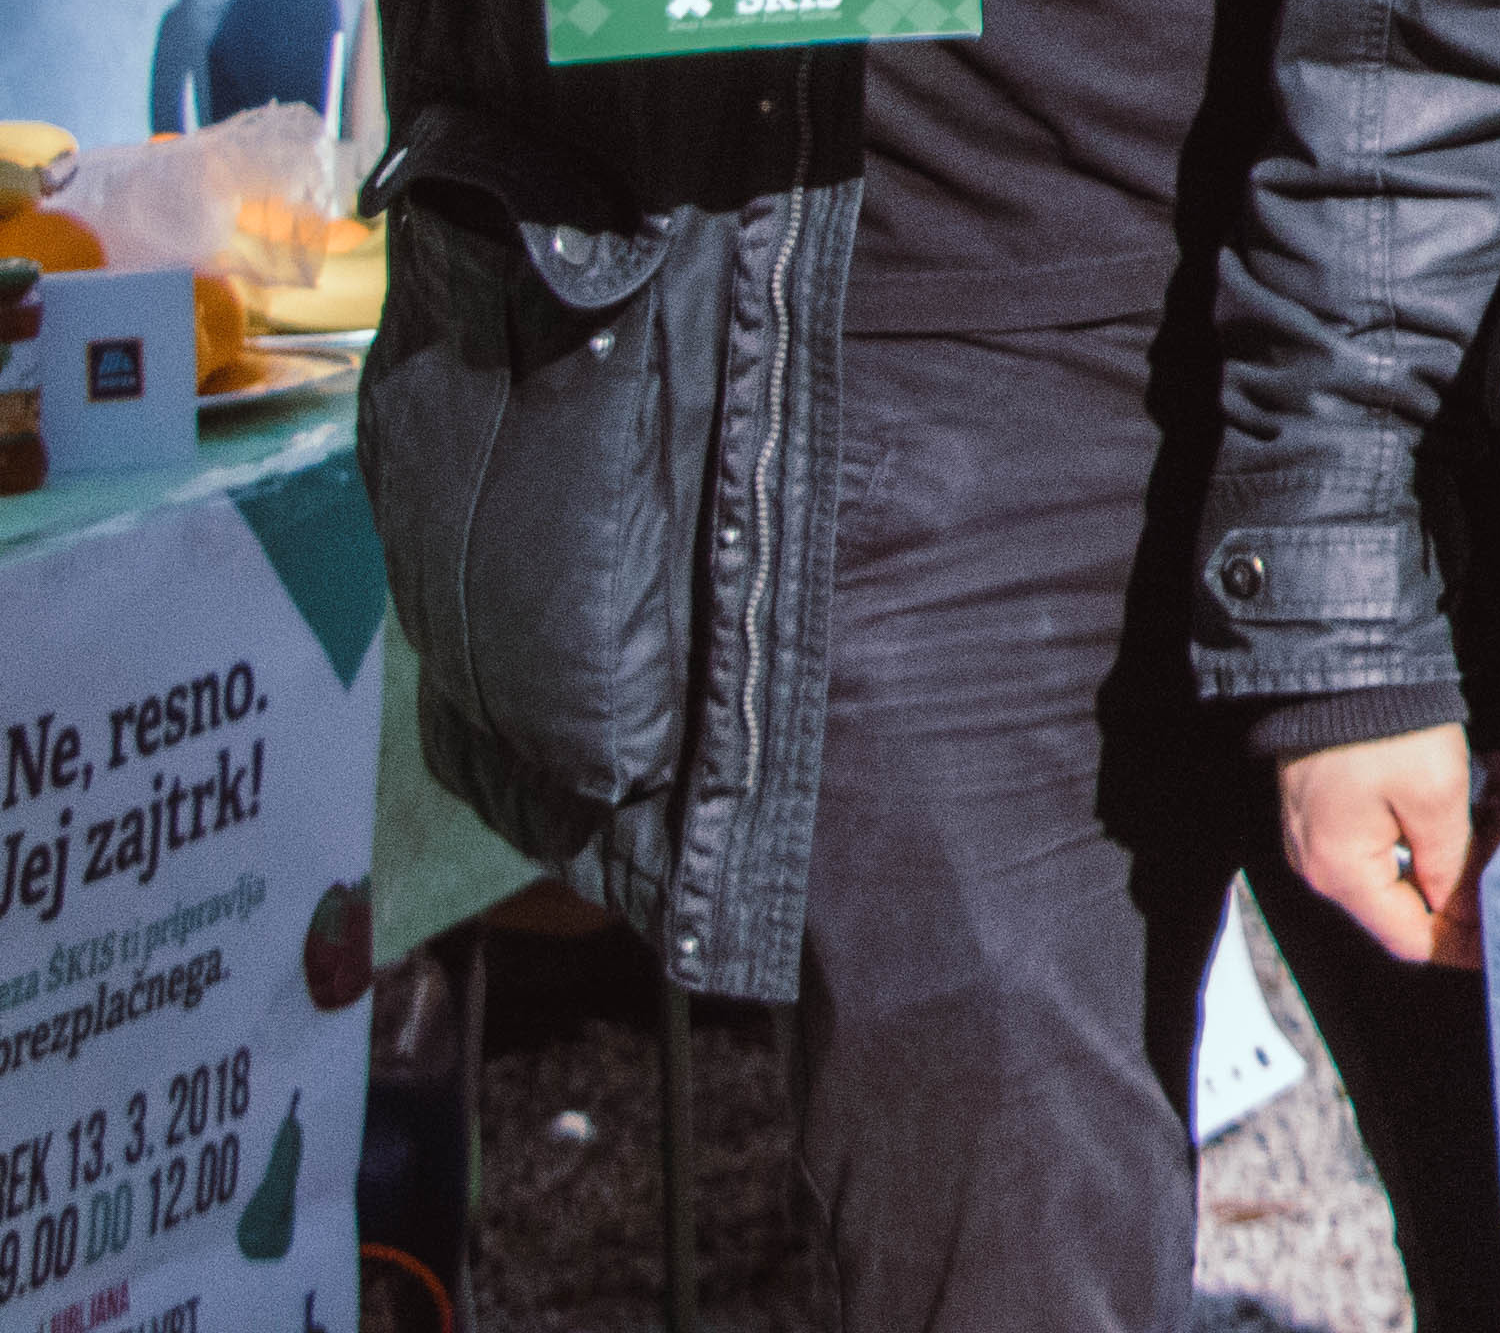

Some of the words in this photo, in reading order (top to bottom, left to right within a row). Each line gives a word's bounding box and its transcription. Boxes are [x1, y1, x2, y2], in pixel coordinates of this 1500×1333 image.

[2, 711, 95, 811] Ne,
[108, 660, 269, 770] resno.
[0, 807, 72, 923] Jej
[82, 737, 266, 885] zajtrk!
[68, 1109, 112, 1191] 13.
[124, 1090, 154, 1165] 3.
[165, 1045, 250, 1146] 2018
[85, 1182, 133, 1265] DO
[150, 1132, 240, 1235] 12.00
